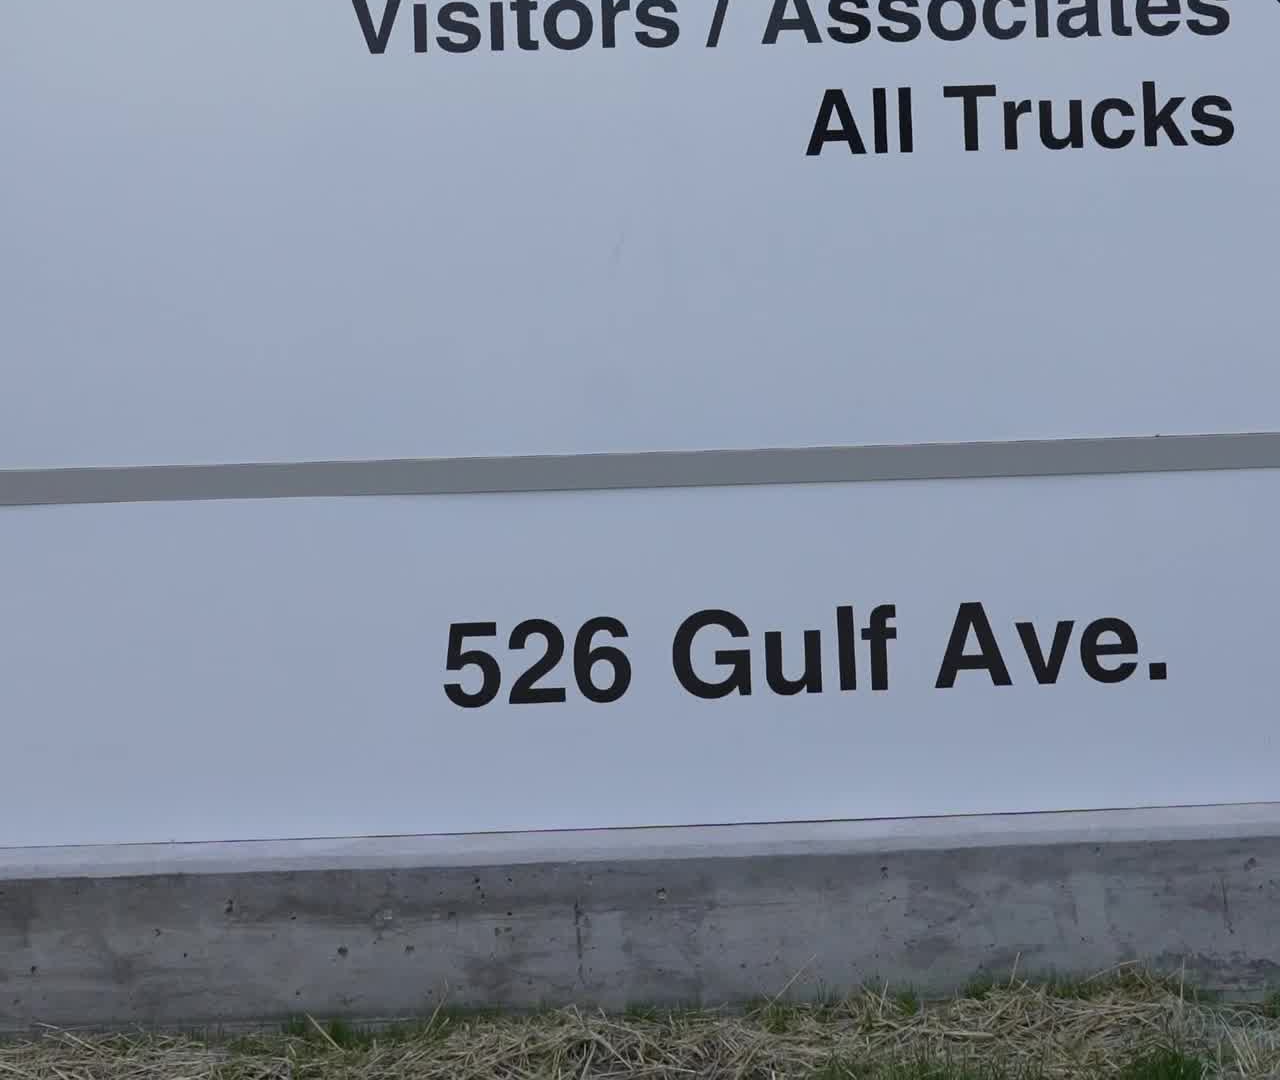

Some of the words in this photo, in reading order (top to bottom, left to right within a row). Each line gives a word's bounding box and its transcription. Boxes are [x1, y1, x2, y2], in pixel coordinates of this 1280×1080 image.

[805, 86, 914, 157] All
[943, 80, 1235, 152] Trucks
[443, 616, 632, 709] 526
[672, 604, 897, 700] Gulf
[934, 601, 1168, 689] Ave.
